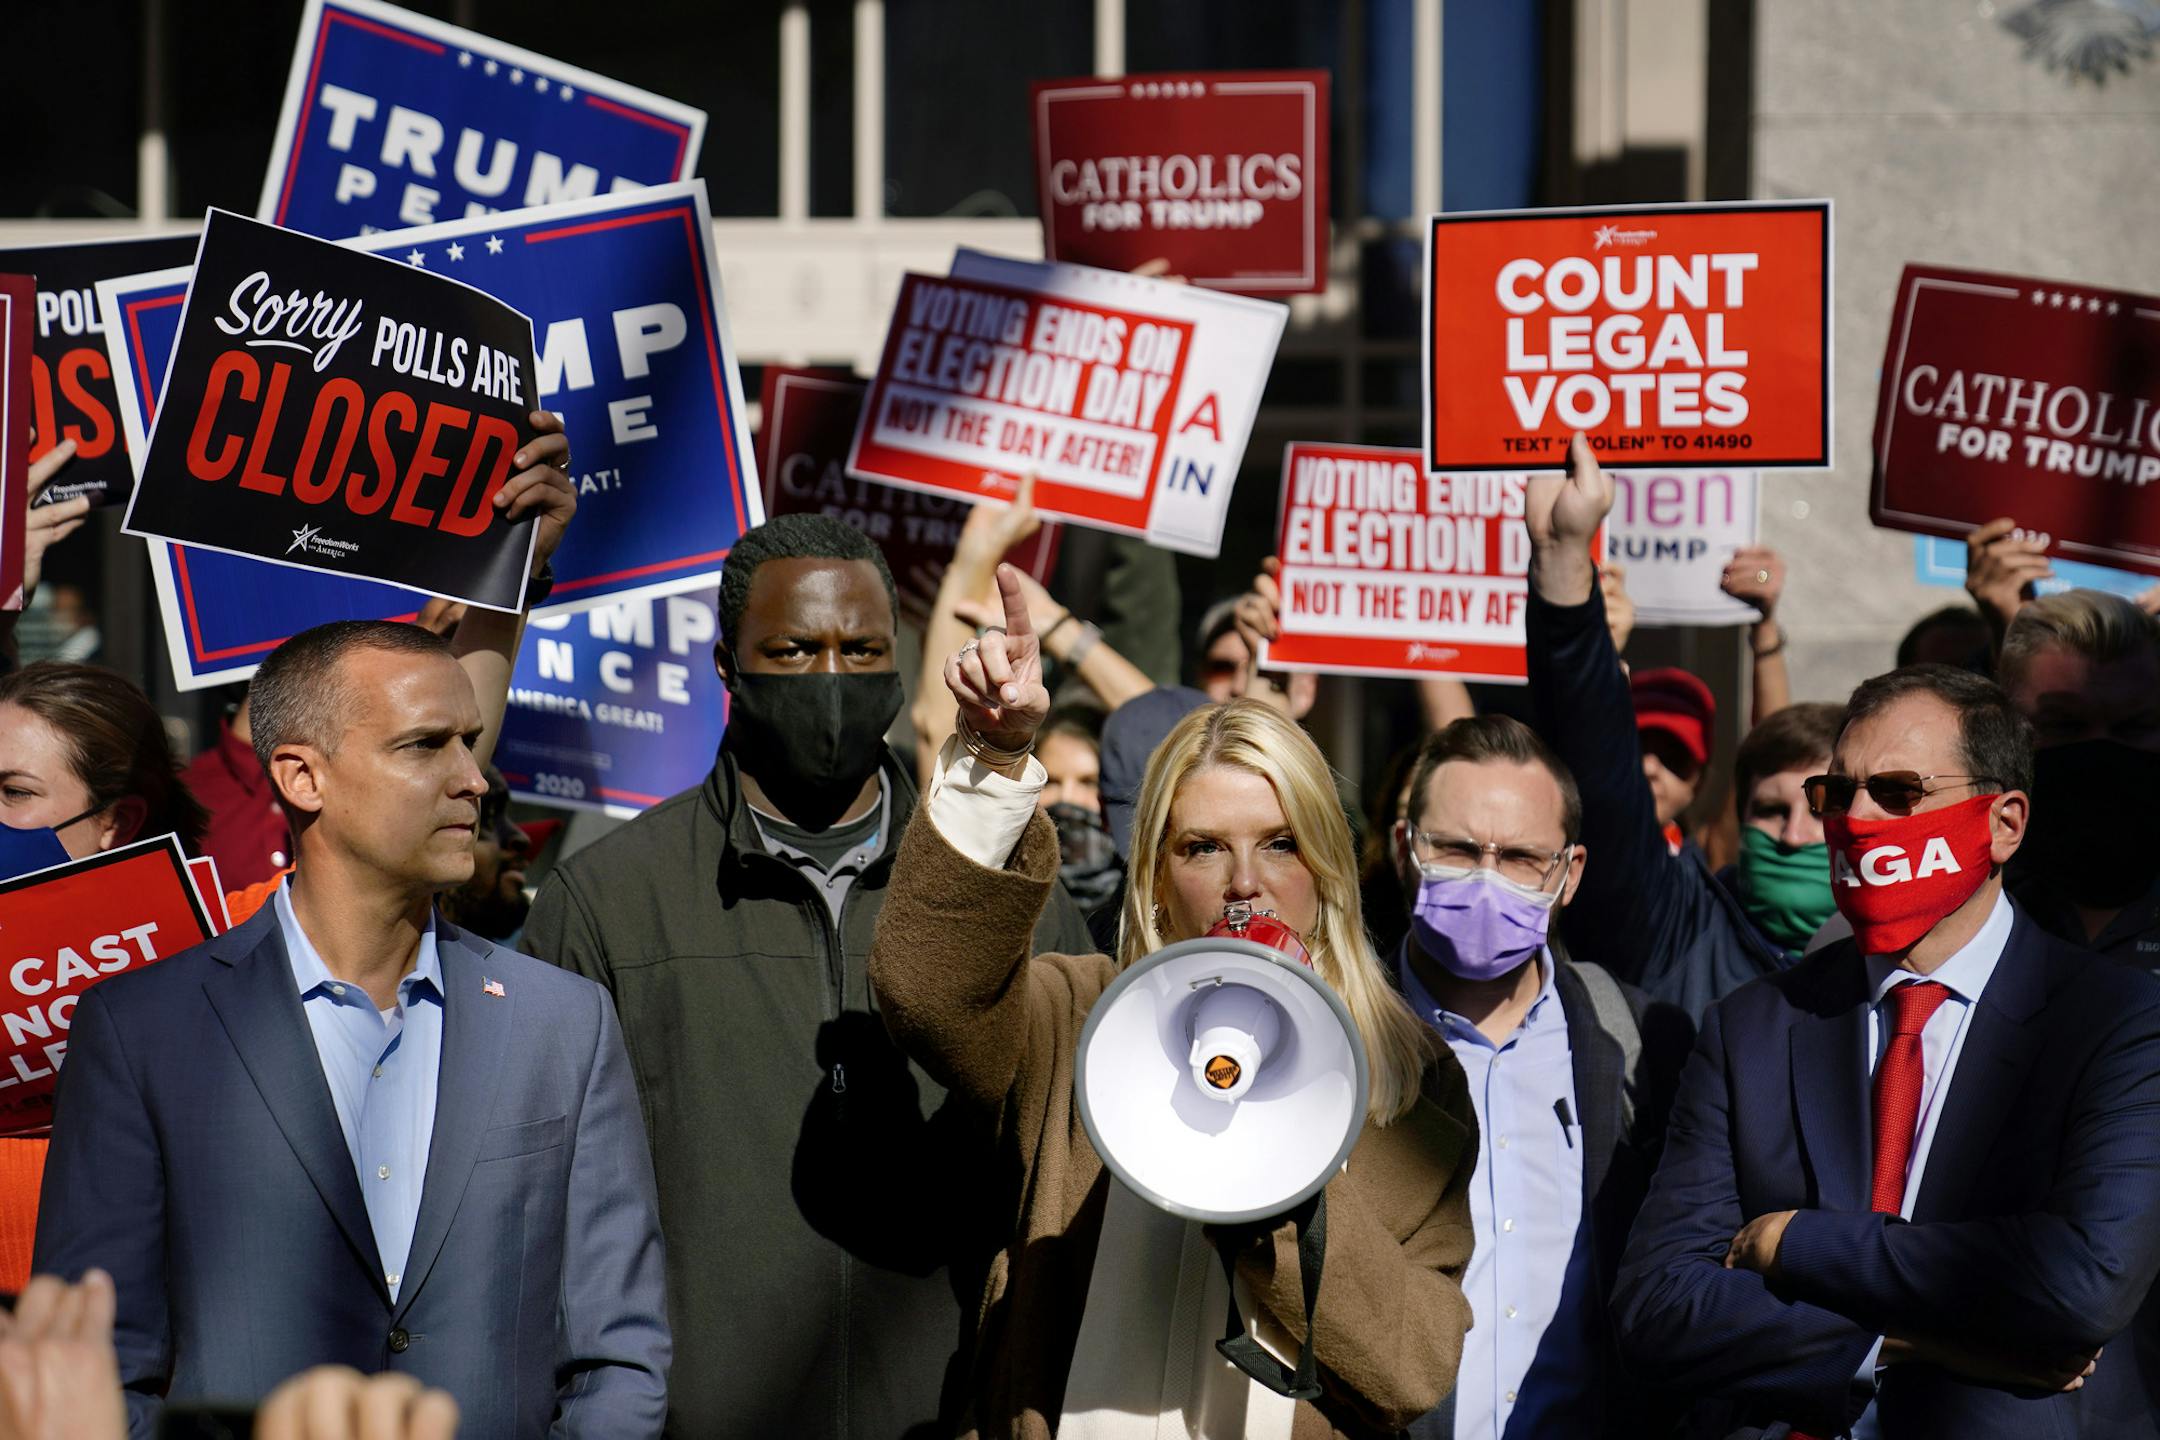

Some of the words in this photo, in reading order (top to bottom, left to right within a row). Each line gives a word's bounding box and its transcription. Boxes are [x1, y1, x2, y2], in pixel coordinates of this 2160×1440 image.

[319, 83, 649, 206] TRUM
[1052, 153, 1302, 206] CATHOLICS
[1081, 200, 1143, 232] FOR
[1149, 199, 1264, 231] TRUMP
[1495, 253, 1760, 314] COUNT
[215, 271, 363, 373] Sorry
[371, 316, 469, 388] POLLS
[471, 345, 524, 406] ARE
[907, 282, 1029, 344] VOTING
[1031, 304, 1129, 367] ENDS
[1128, 322, 1182, 376] ON
[1506, 313, 1749, 371] LEGAL
[893, 329, 1081, 416] ELECTION
[1081, 363, 1170, 430] DAY
[1503, 372, 1750, 431] VOTES
[186, 350, 519, 537] CLOSED
[885, 395, 934, 434] NOT
[943, 407, 991, 447] THE
[1000, 418, 1050, 460] DAY
[1059, 430, 1146, 479] AFTER!
[1503, 437, 1553, 453] TEXT
[1663, 434, 1689, 450] TO
[1693, 433, 1753, 450] 41490
[1937, 423, 2012, 463] FOR
[2023, 436, 2160, 487] TRUMP
[1296, 456, 1418, 513] VOTING
[311, 535, 360, 552] FreedomWorks
[1285, 507, 1486, 575] ELECTION
[1292, 581, 1343, 616] NOT
[1356, 582, 1408, 621] THE
[1418, 583, 1472, 625] DAY
[1484, 590, 1527, 626] AF
[596, 703, 664, 735] GREAT!
[534, 772, 585, 799] 2020
[1831, 836, 1962, 888] AGA
[9, 921, 159, 996] CAST
